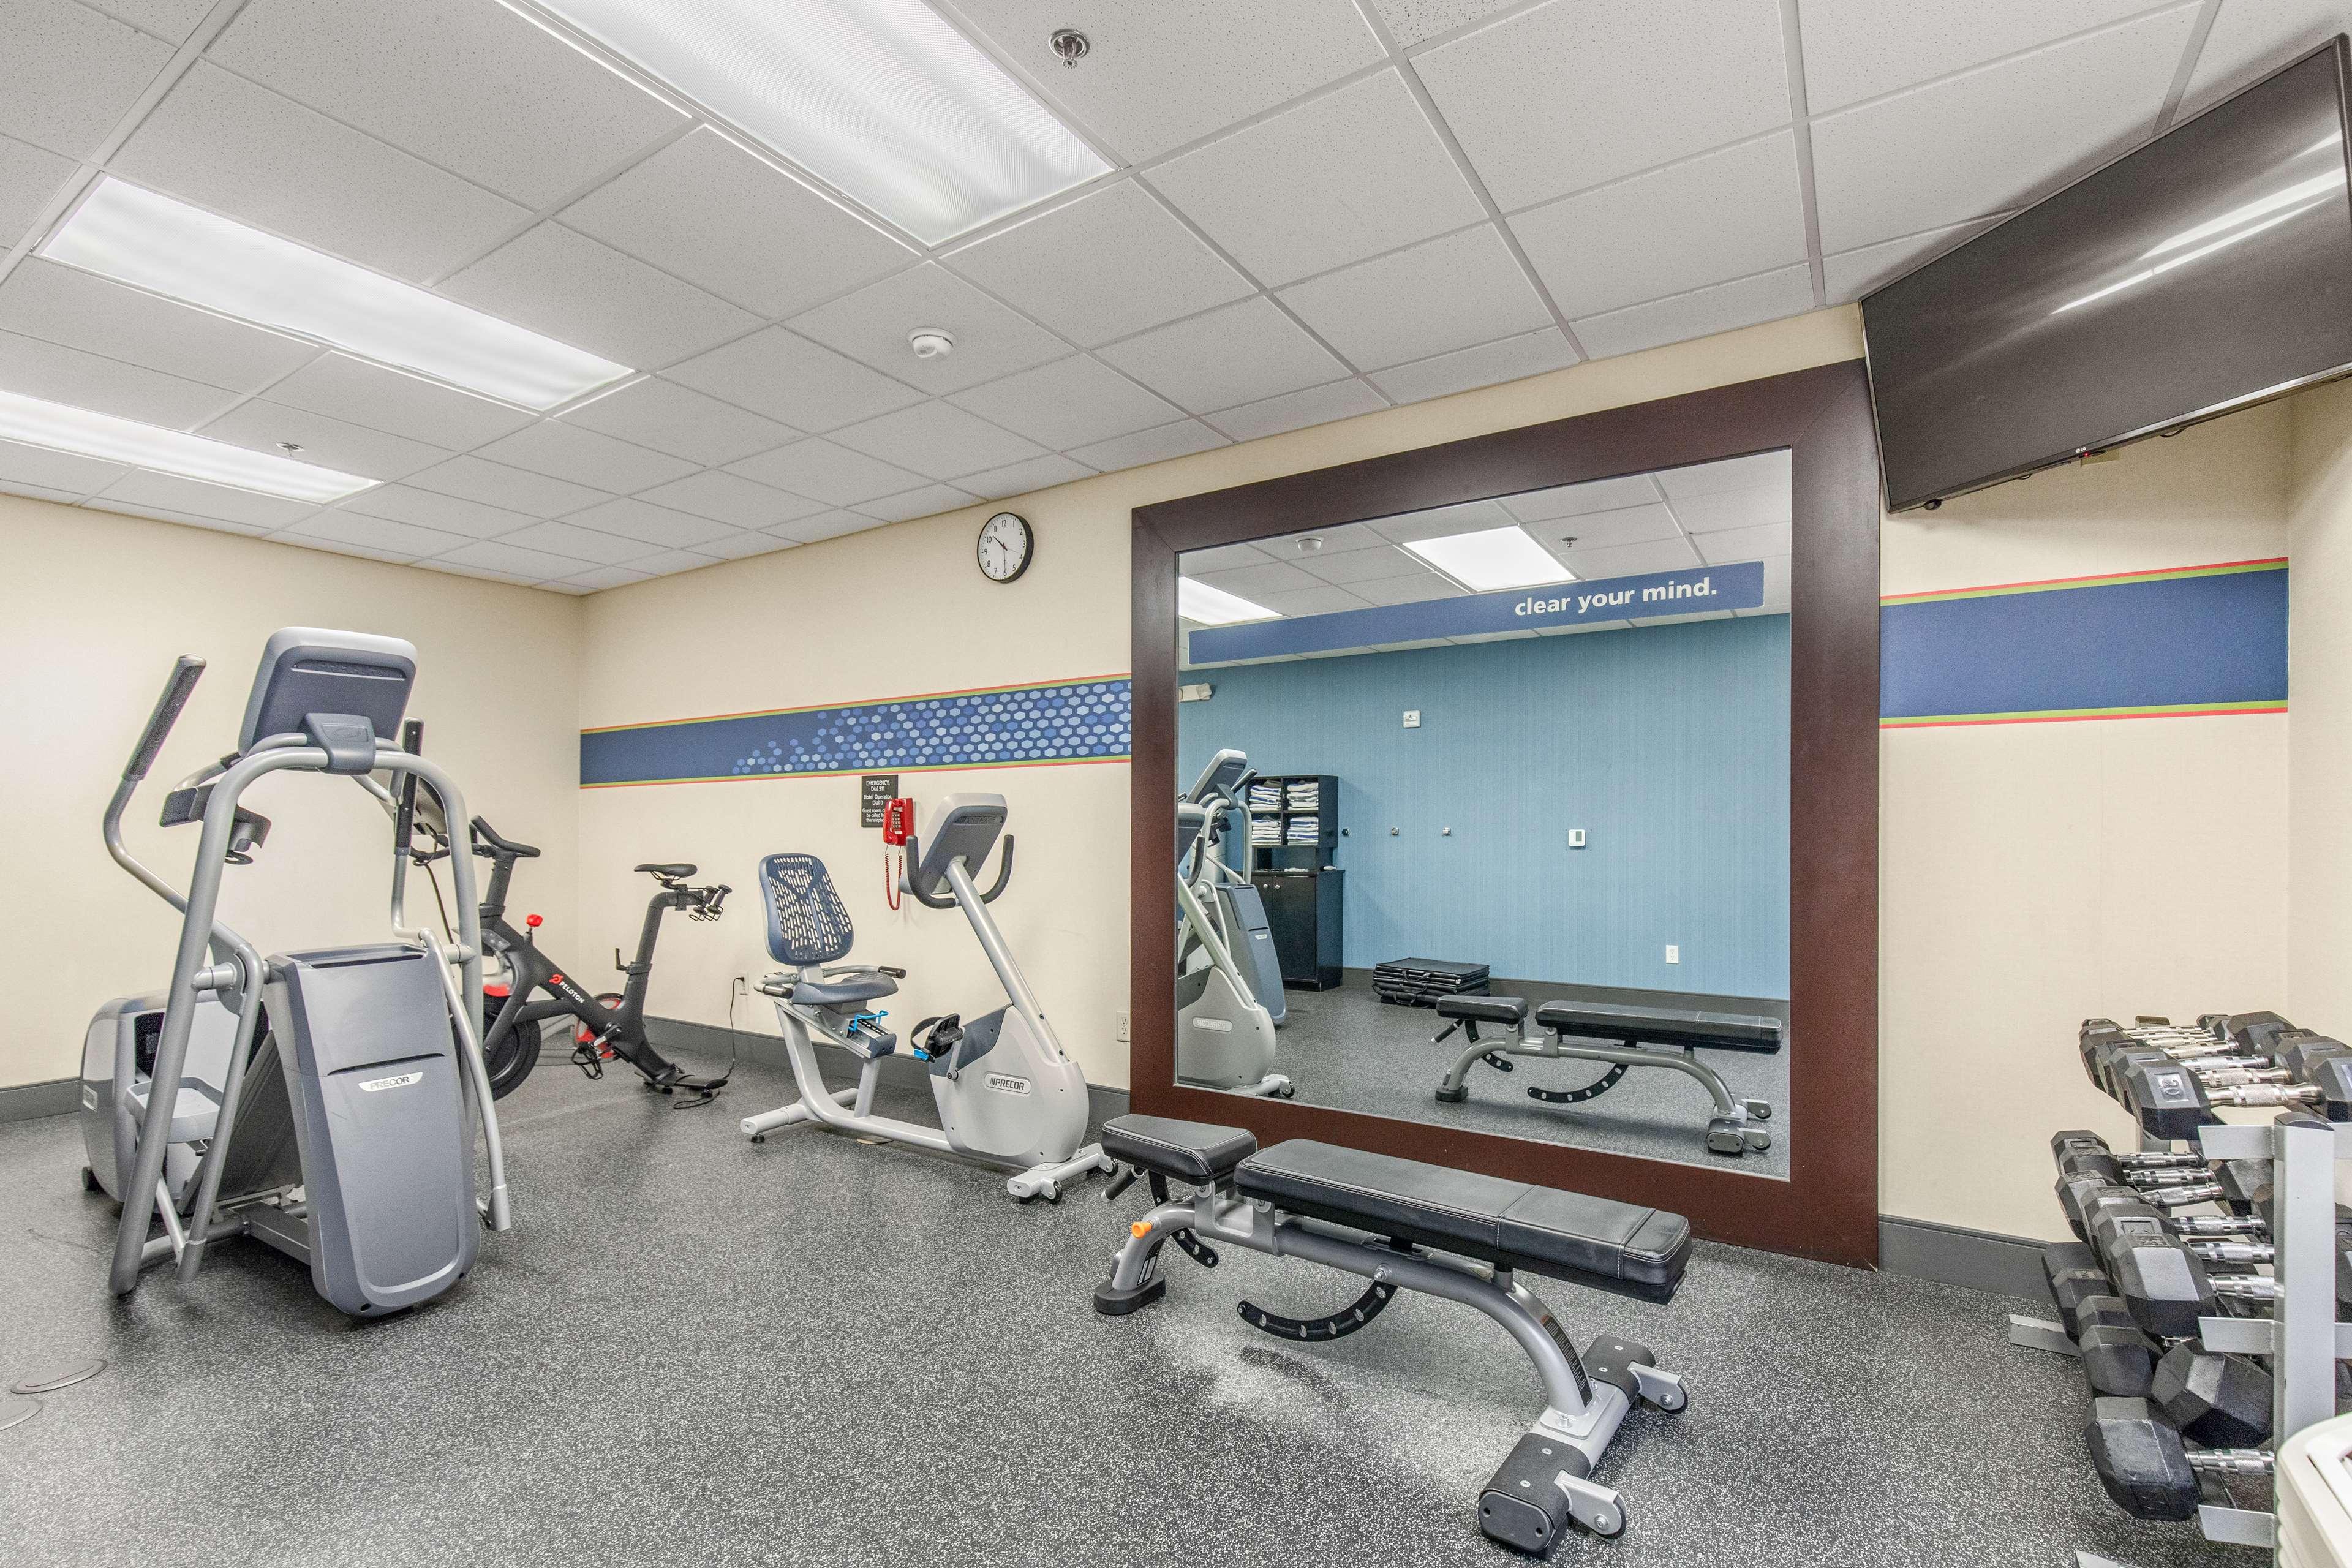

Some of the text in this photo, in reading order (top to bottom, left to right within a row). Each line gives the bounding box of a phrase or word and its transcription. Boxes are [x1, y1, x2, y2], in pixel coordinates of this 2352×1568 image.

[1515, 577, 1717, 616] clear your mind.
[559, 981, 585, 1003] PELOTON
[370, 1076, 410, 1090] PRECOR
[994, 1078, 1025, 1090] PRECOR
